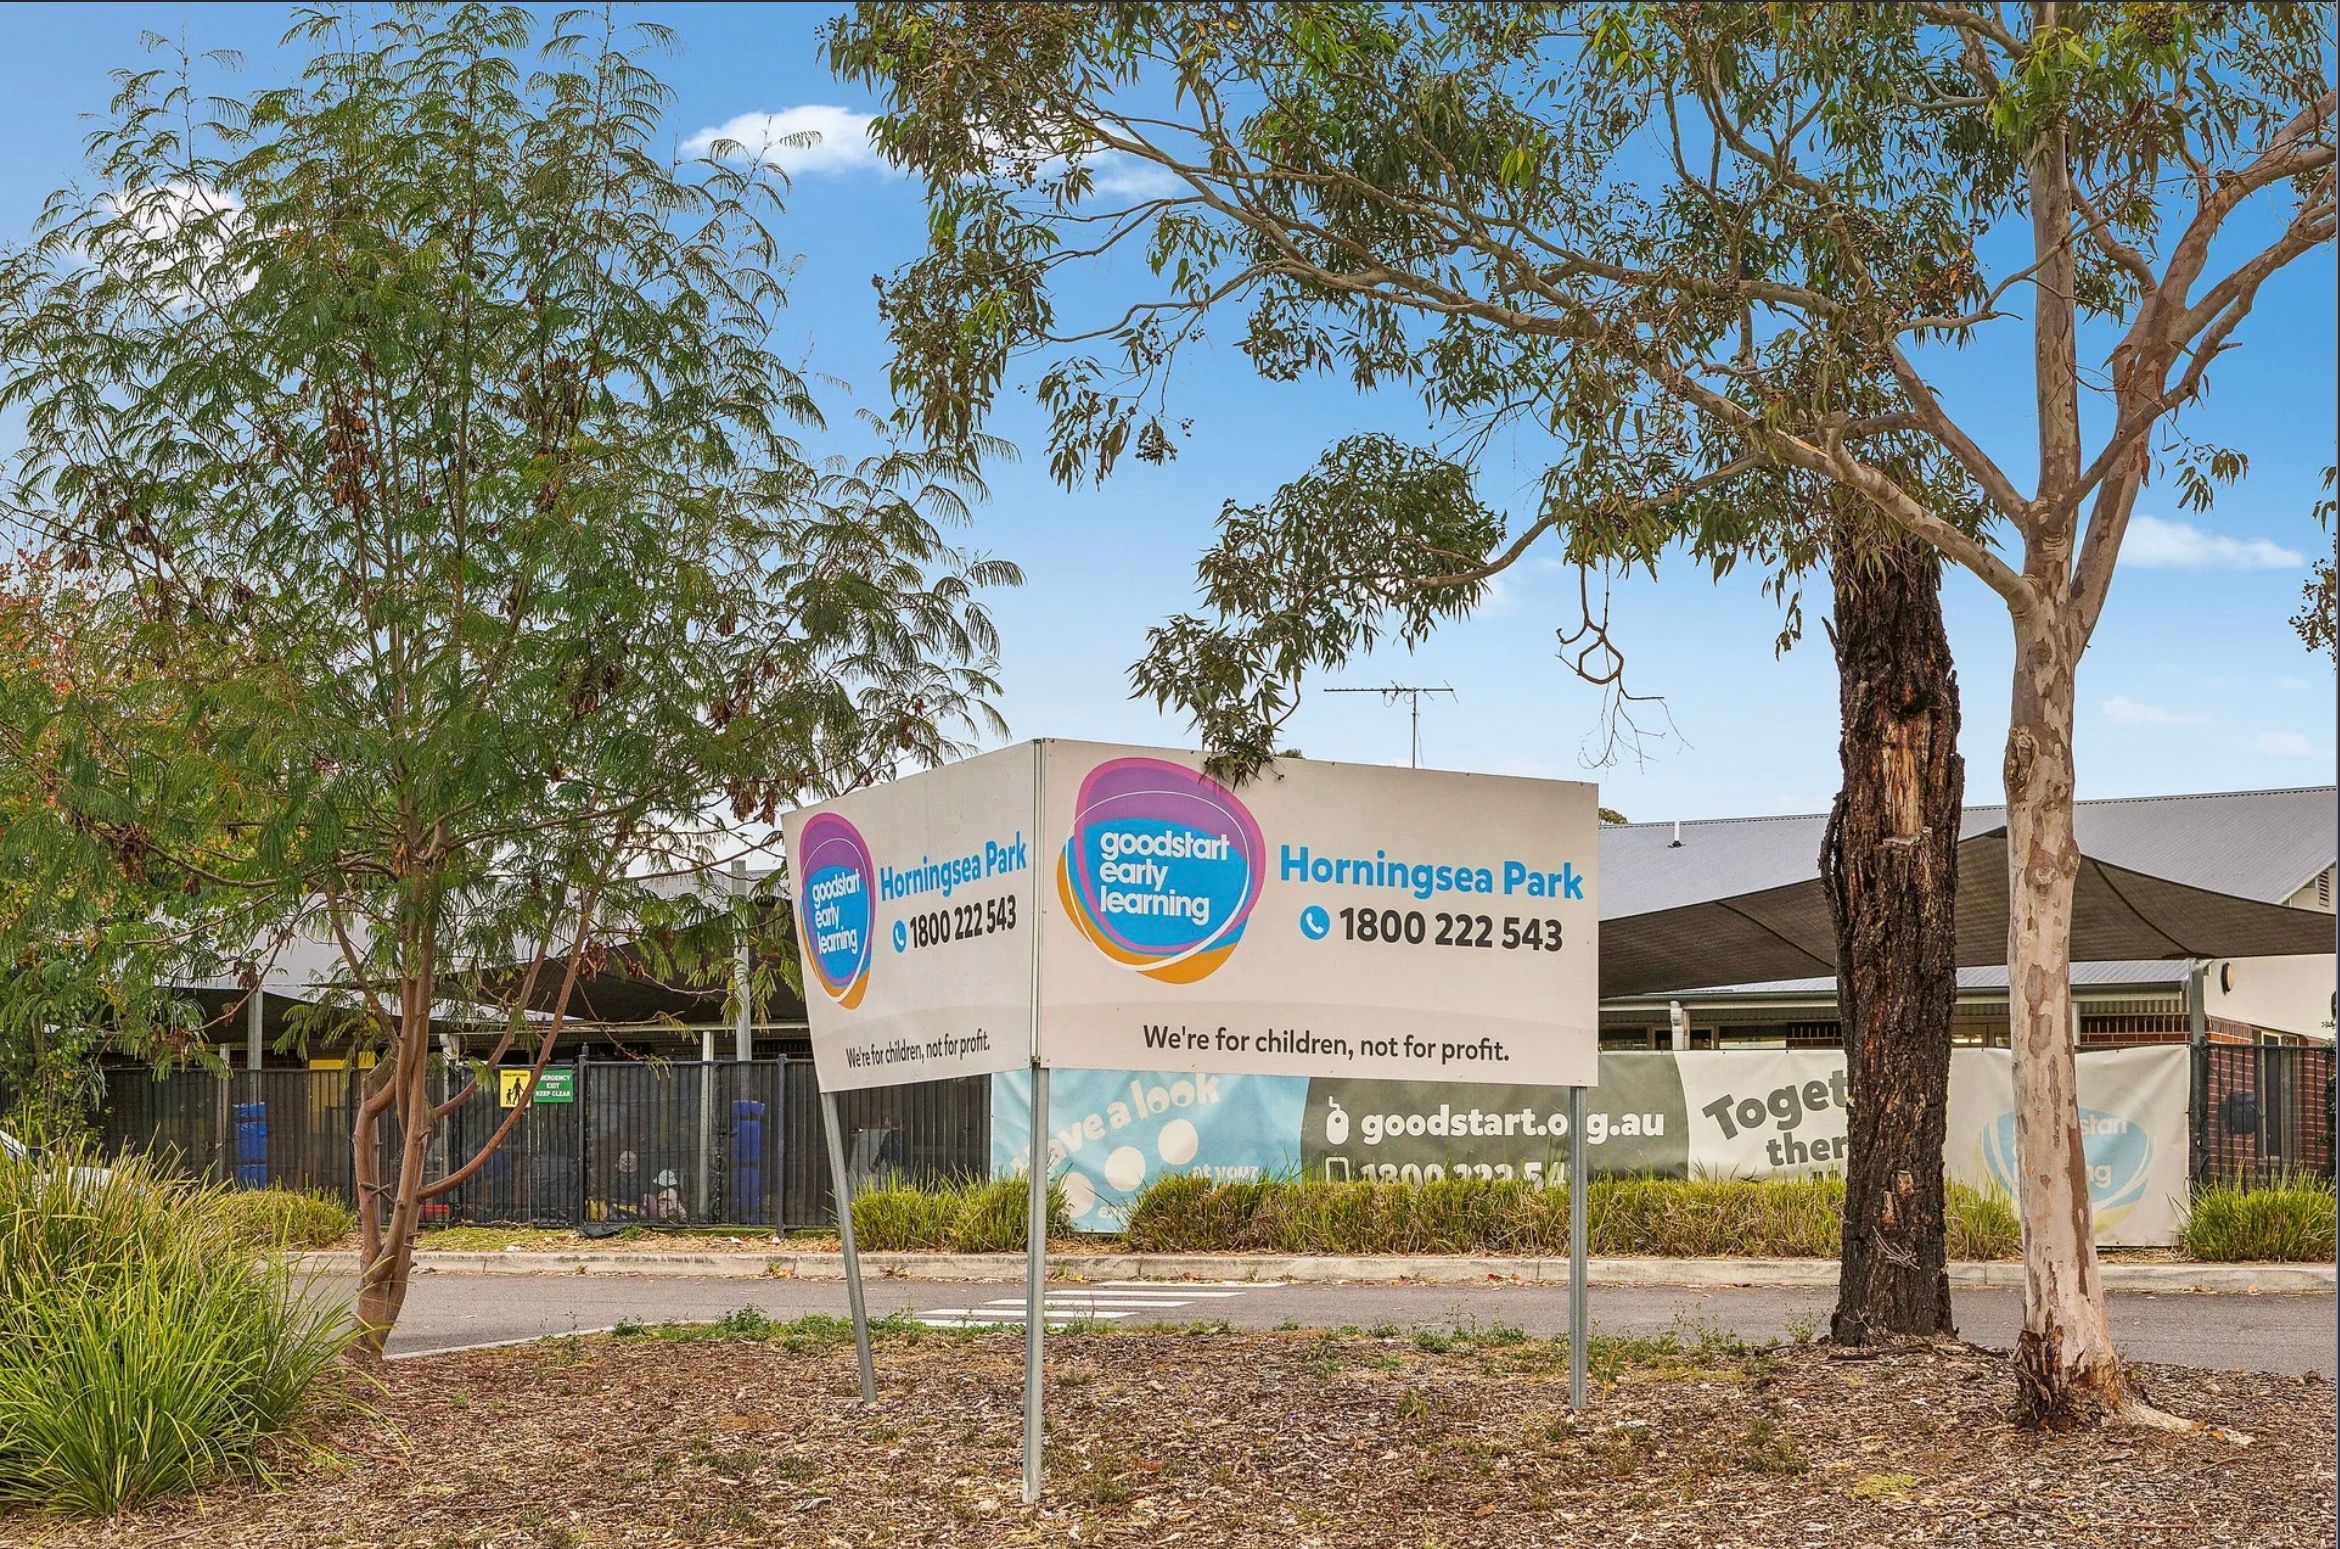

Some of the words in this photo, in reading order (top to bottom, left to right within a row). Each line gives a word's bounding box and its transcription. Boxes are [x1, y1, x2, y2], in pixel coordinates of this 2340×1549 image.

[880, 855, 981, 901] Horningsea
[985, 831, 1027, 877] Park
[1100, 830, 1230, 861] goodstart
[812, 868, 860, 909] goodstart
[1099, 858, 1169, 892] early
[1280, 844, 1493, 900] Horningsea
[1503, 861, 1584, 900] Park
[815, 901, 840, 930] early
[910, 910, 950, 949] 1800
[954, 902, 983, 940] 222
[986, 895, 1017, 934] 543
[1100, 885, 1210, 926] learning
[817, 926, 858, 954] learning
[1339, 907, 1426, 944] 1800
[1435, 912, 1493, 948] 222
[1501, 916, 1563, 952] 543
[846, 1046, 870, 1068] We're
[871, 1043, 884, 1066] for
[885, 1039, 924, 1064] children,
[926, 1038, 942, 1059] not
[944, 1033, 958, 1056] for
[960, 1028, 990, 1060] profit.
[1143, 1025, 1209, 1050] We're
[1215, 1027, 1250, 1051] for
[1255, 1029, 1354, 1061] children,
[1360, 1036, 1399, 1058] not
[1404, 1035, 1436, 1059] for
[1441, 1038, 1510, 1065] profit.
[1107, 1100, 1132, 1129] a
[1130, 1073, 1220, 1120] look
[1702, 1069, 1848, 1140] Toget
[1361, 1104, 1664, 1146] goodstart.og.au
[1524, 1162, 1567, 1190] 54
